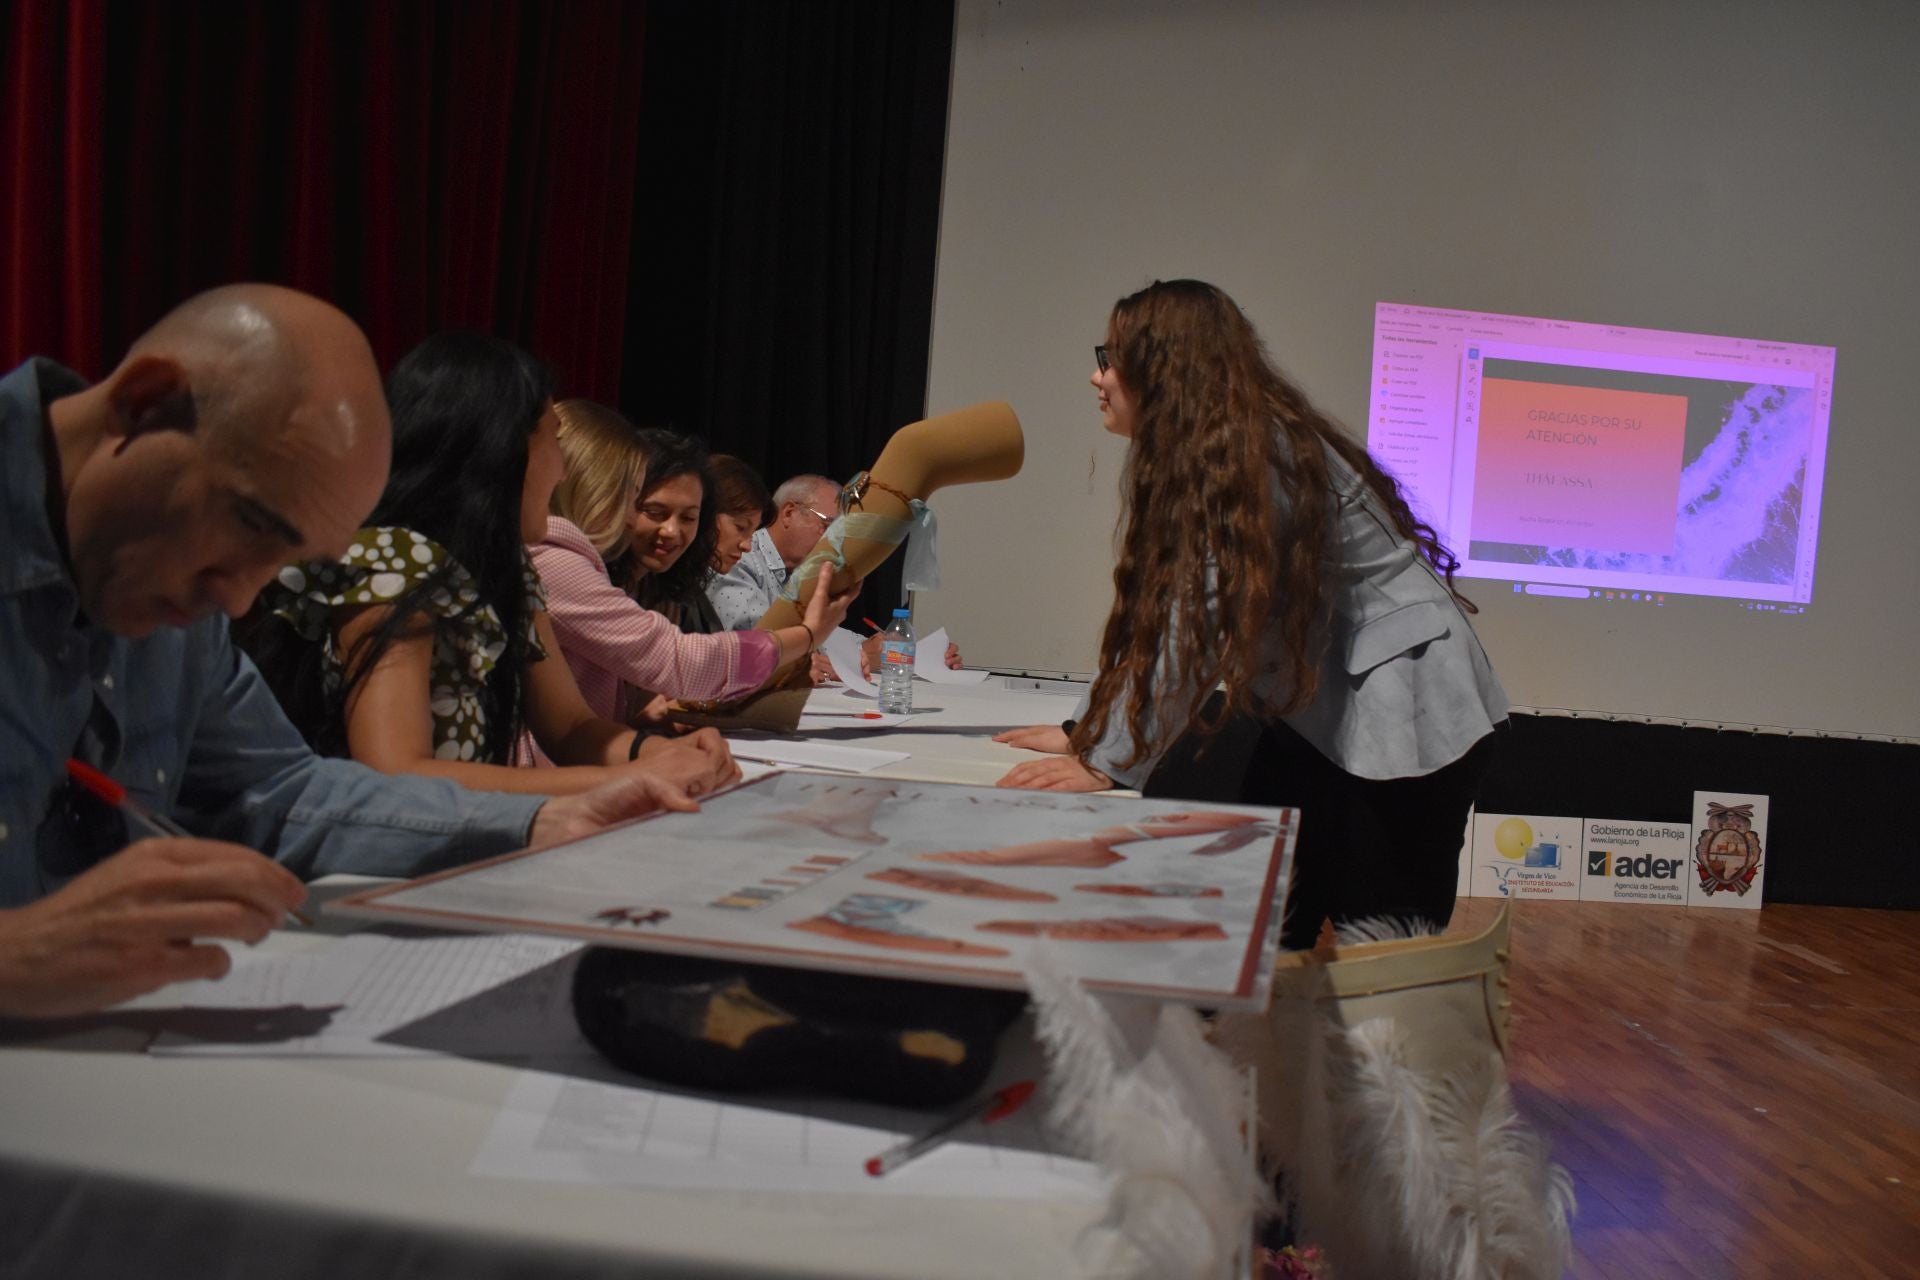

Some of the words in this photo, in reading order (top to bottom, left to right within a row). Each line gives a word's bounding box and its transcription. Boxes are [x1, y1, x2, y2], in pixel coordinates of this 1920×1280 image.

[1527, 409, 1588, 426] GRACIAS
[1591, 415, 1620, 428] POR
[1623, 418, 1643, 430] SU
[1590, 824, 1634, 837] Gobierno
[1636, 828, 1649, 837] de
[1650, 828, 1661, 838] La
[1662, 828, 1685, 840] Rioja
[1614, 853, 1683, 879] ader
[1614, 882, 1639, 890] Agencia
[1666, 892, 1682, 900] Rioja
